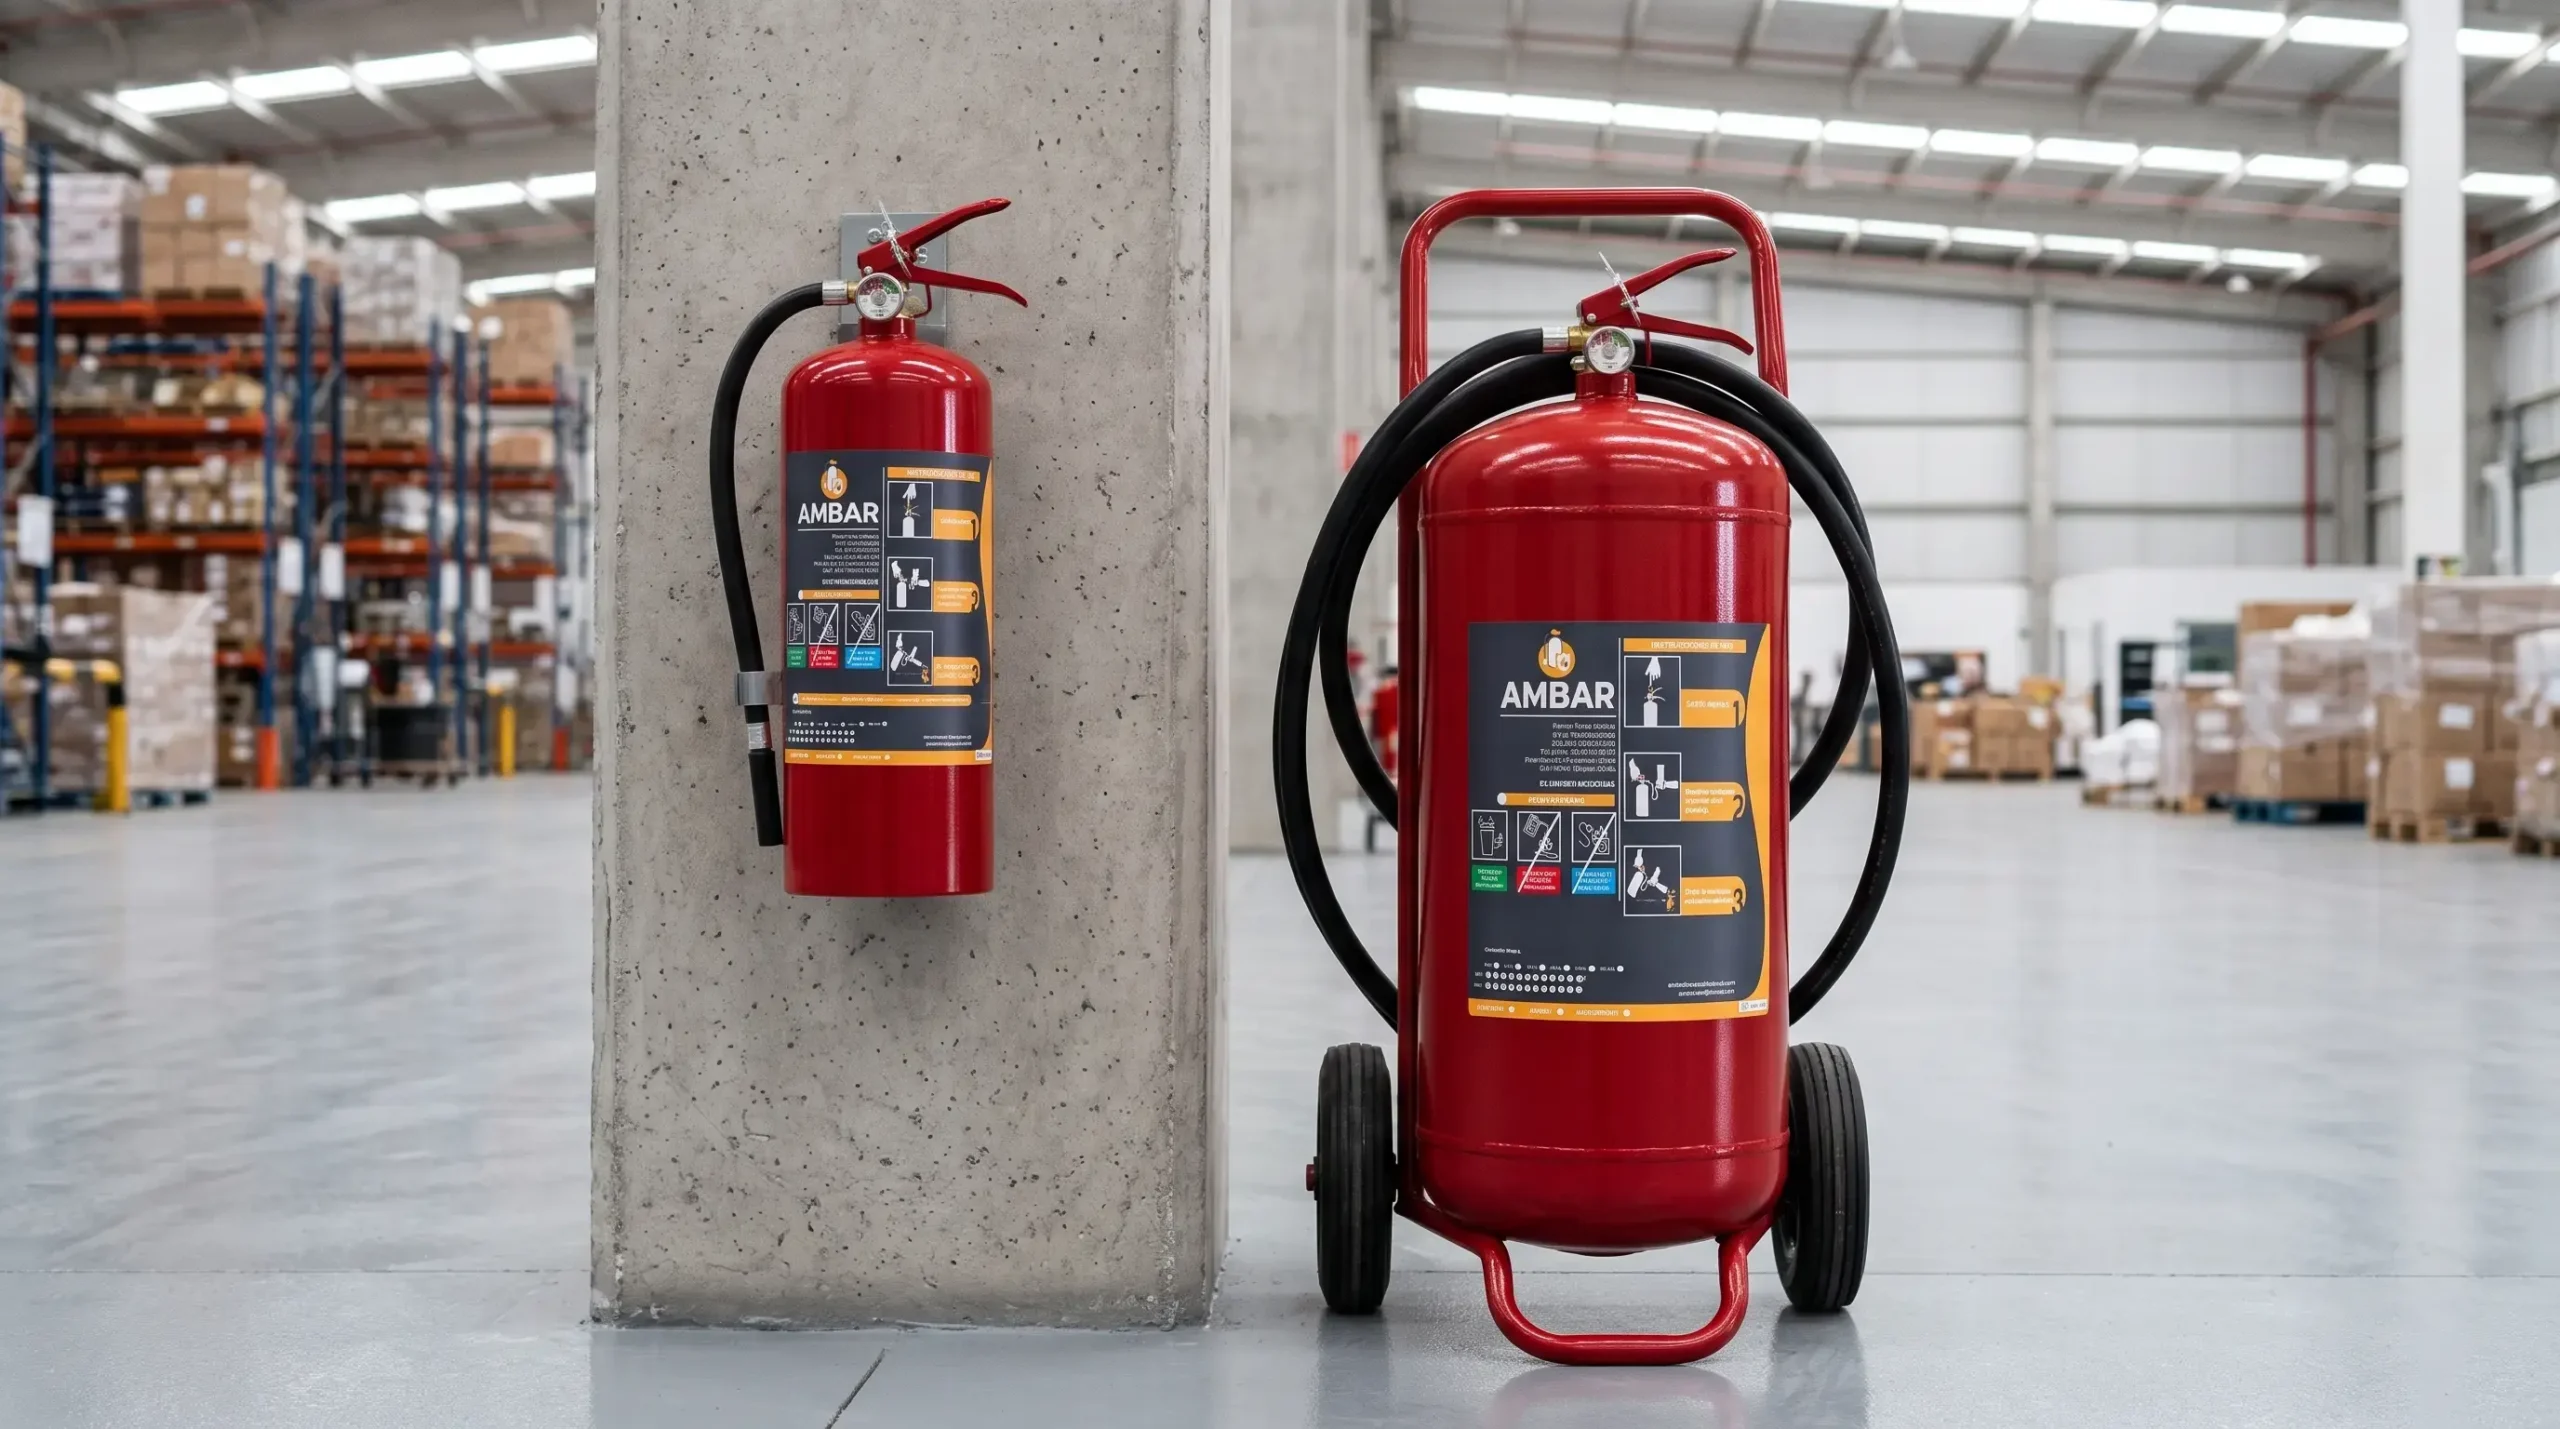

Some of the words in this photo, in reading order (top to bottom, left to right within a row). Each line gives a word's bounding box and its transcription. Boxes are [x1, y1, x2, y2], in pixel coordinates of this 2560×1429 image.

[798, 502, 879, 524] AMBAR
[1500, 681, 1615, 709] AMBAR
[1732, 888, 1744, 914] 3
